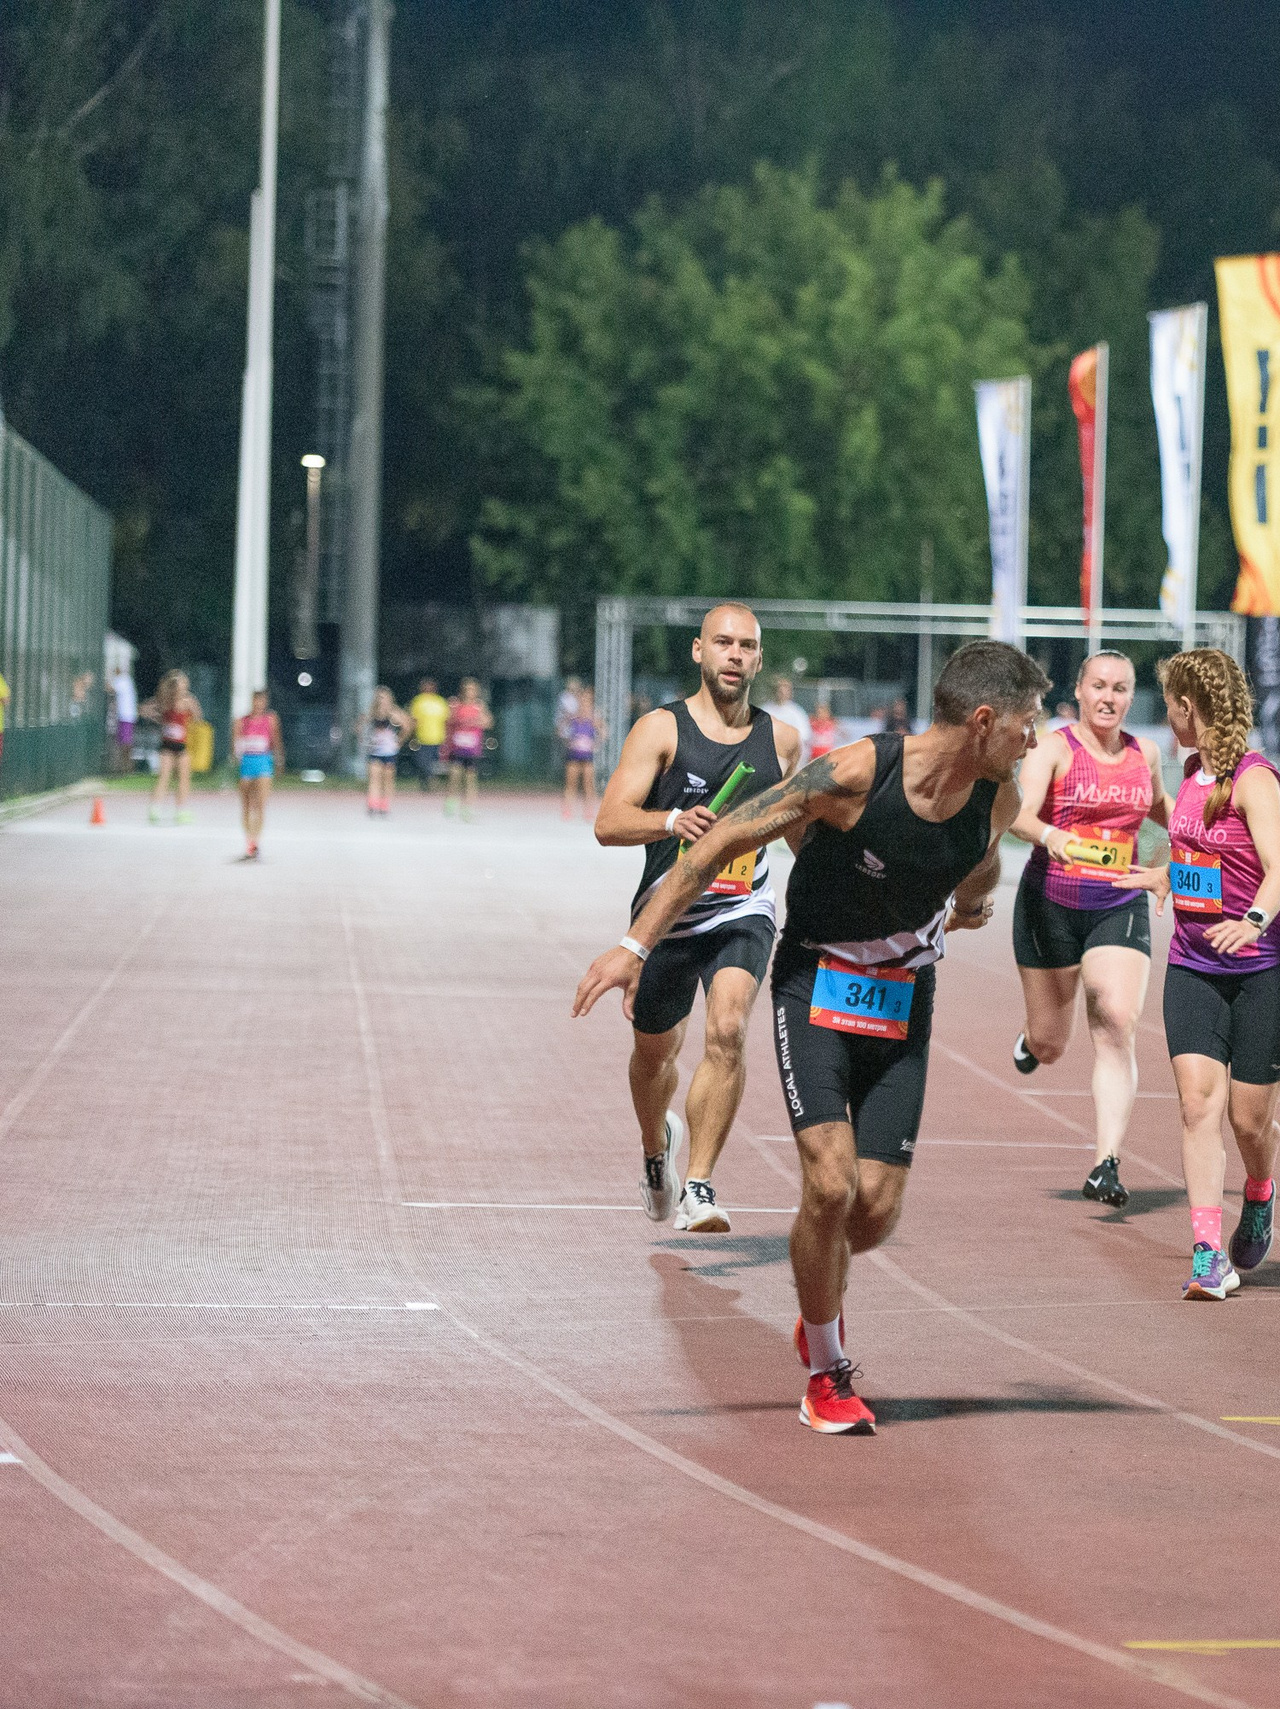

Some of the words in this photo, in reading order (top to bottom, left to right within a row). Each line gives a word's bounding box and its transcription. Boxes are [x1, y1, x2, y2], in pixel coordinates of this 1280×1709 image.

[740, 865, 747, 876] 2
[1177, 870, 1200, 892] 340
[1207, 883, 1213, 893] 3
[845, 982, 887, 1012] 341
[893, 1000, 902, 1014] 3
[777, 1007, 792, 1070] ATHLETES
[785, 1072, 804, 1117] LOCAL
